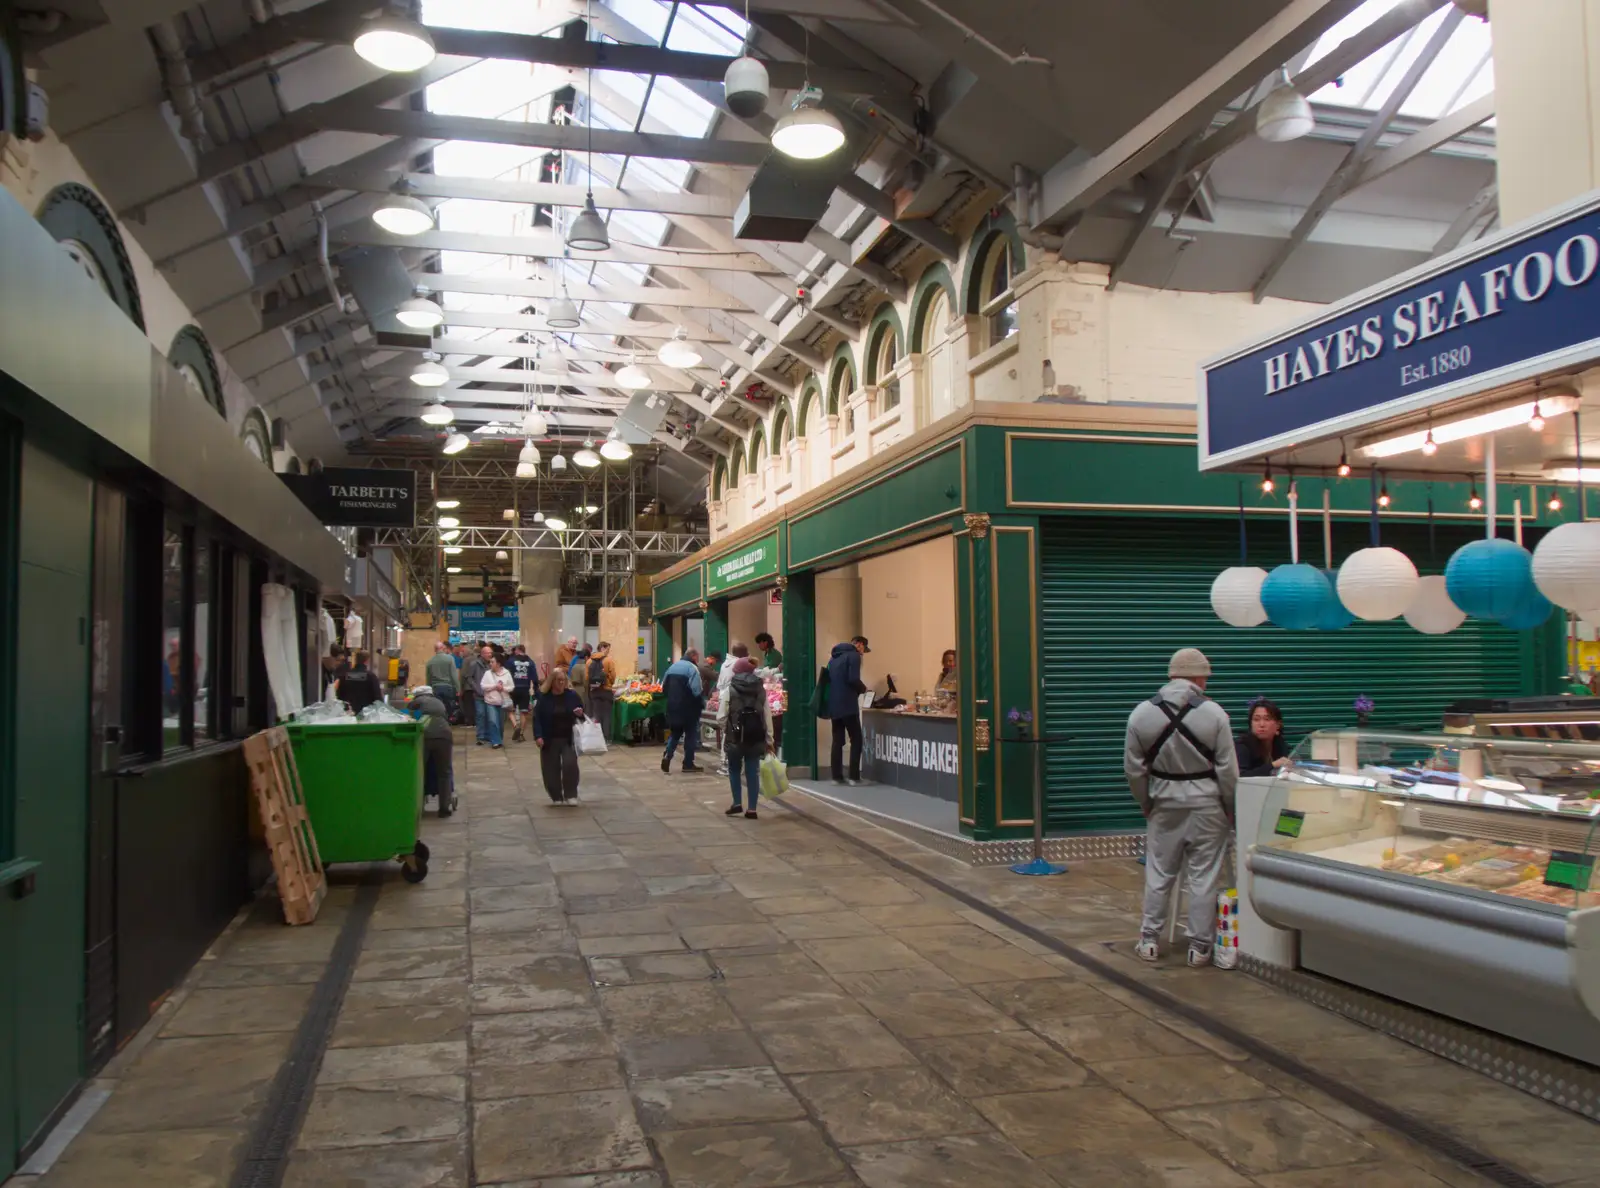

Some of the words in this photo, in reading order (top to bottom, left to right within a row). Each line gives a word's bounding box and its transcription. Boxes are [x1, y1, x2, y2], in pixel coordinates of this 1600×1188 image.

[1263, 315, 1383, 396] HAYES
[1393, 226, 1600, 349] SEAFOO
[329, 485, 408, 499] TARBETT'S
[339, 501, 397, 509] FISHMONGERS
[876, 734, 919, 767] BLUEBIRD
